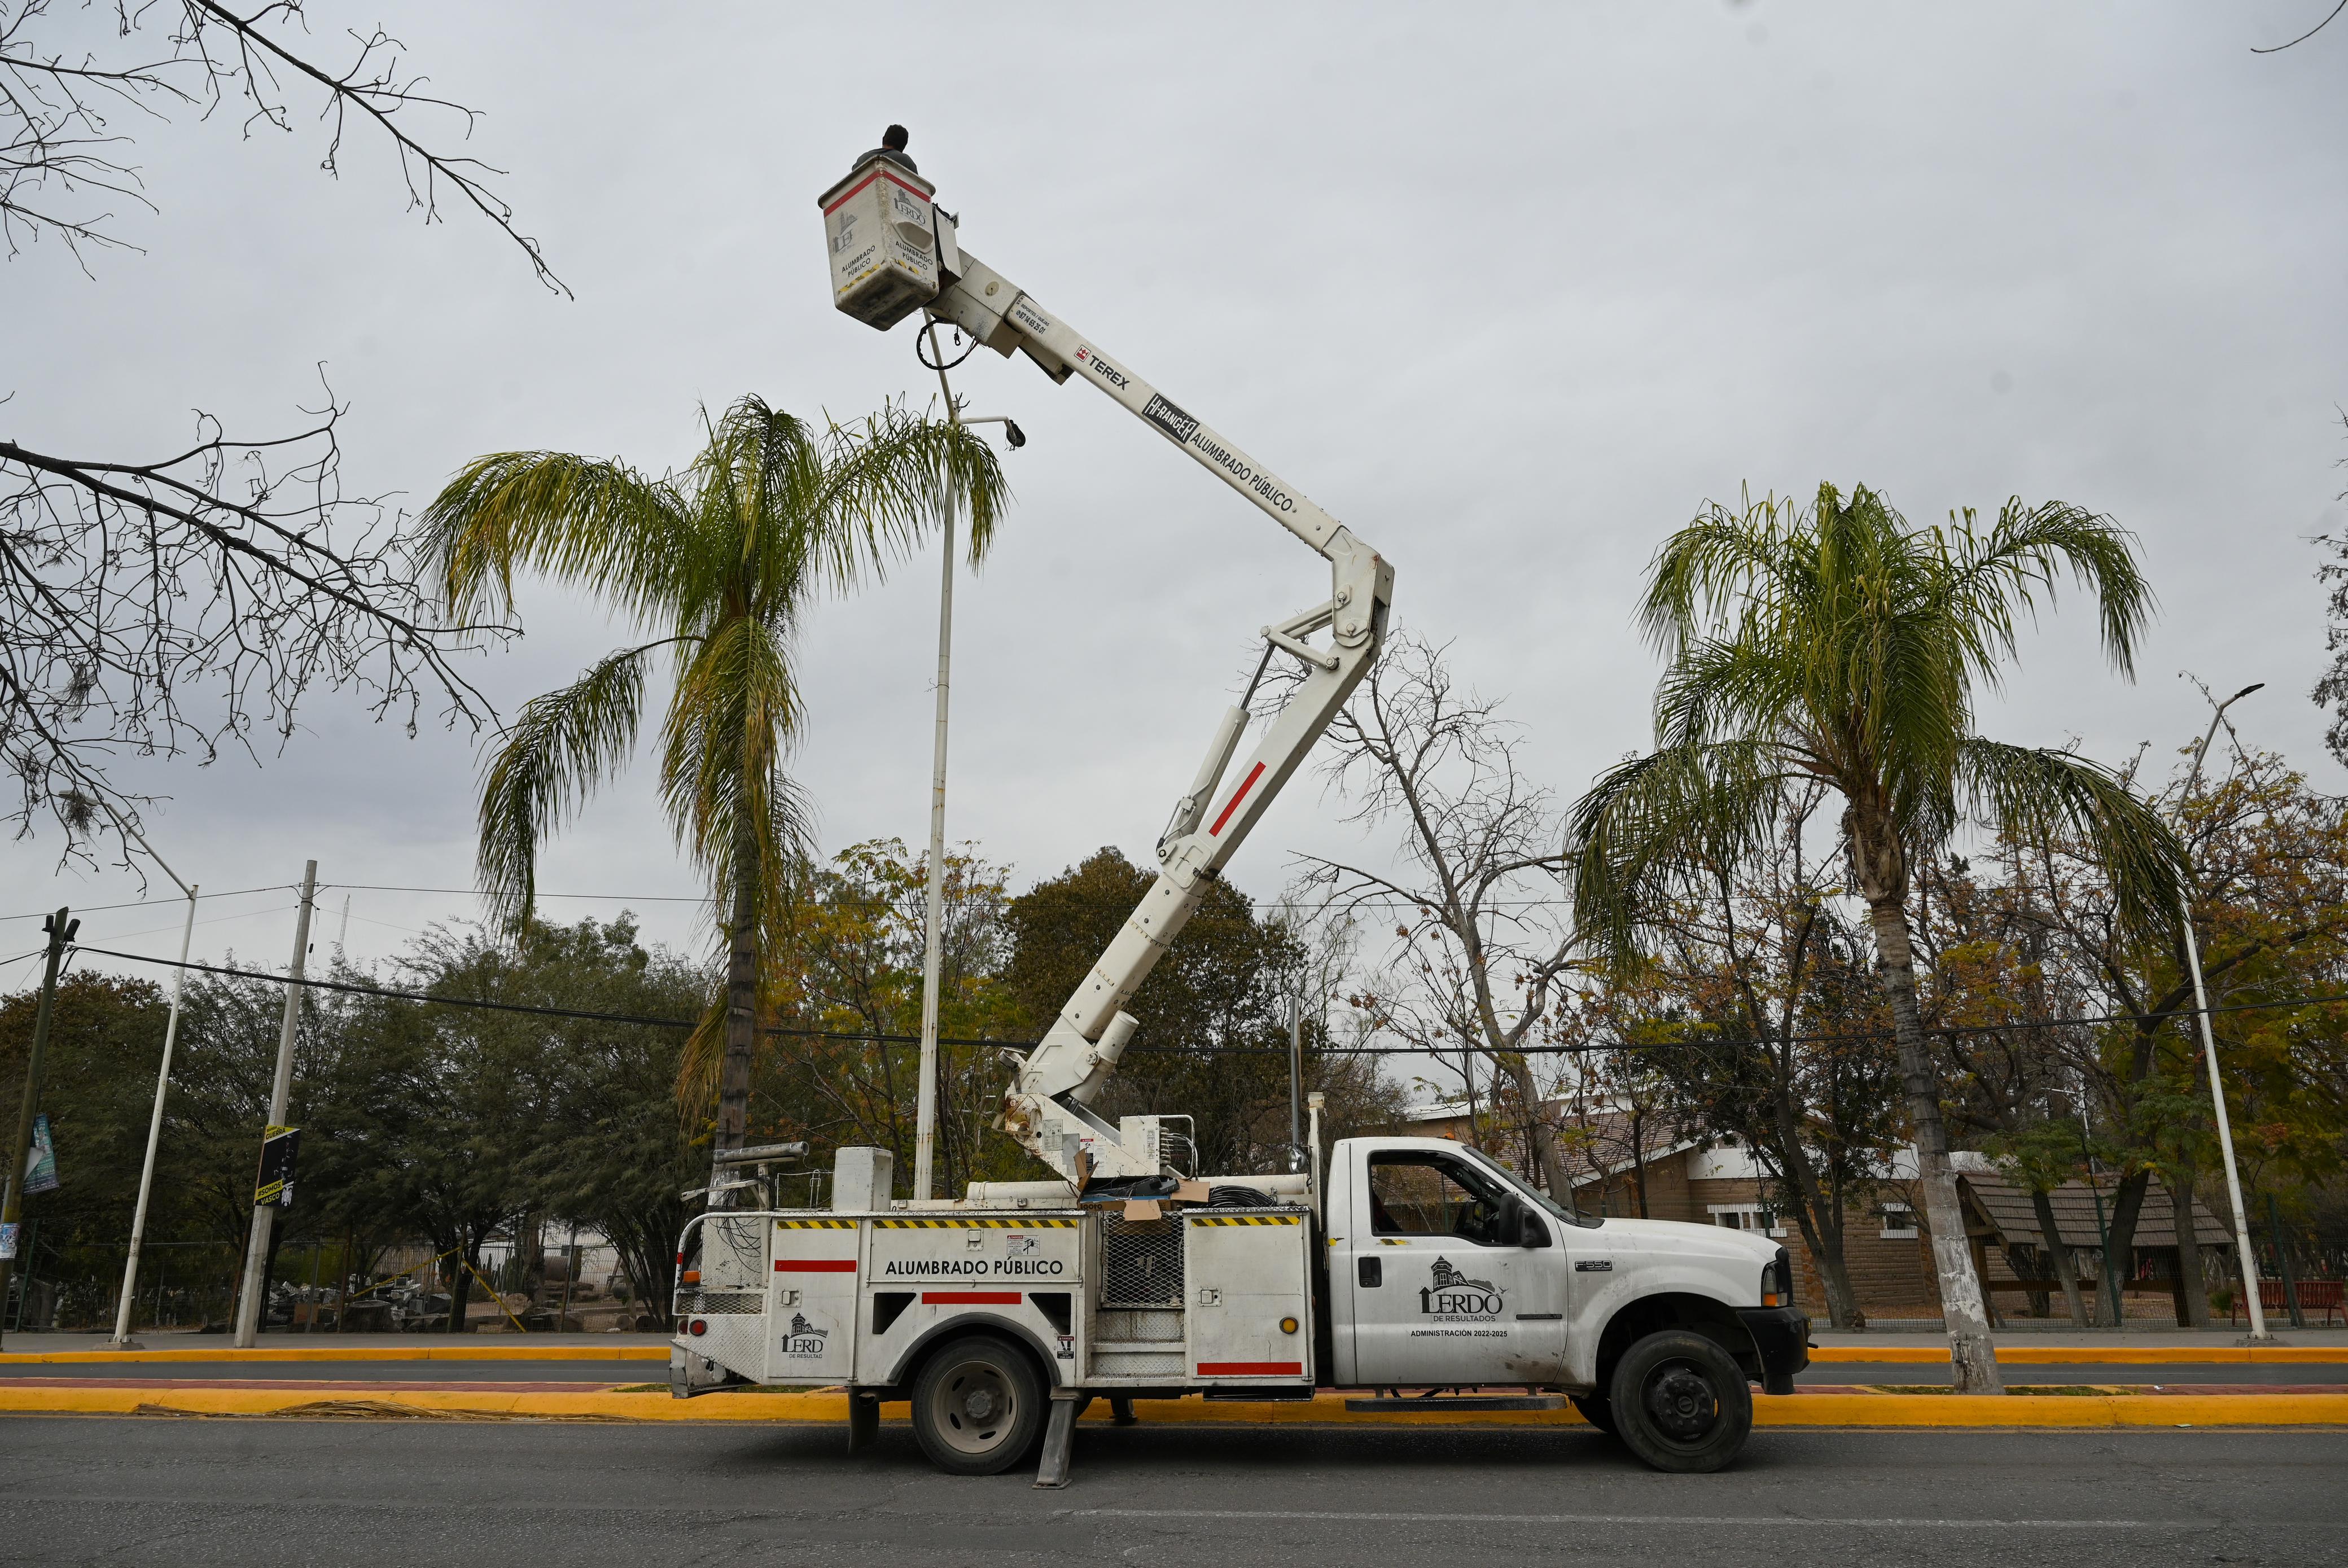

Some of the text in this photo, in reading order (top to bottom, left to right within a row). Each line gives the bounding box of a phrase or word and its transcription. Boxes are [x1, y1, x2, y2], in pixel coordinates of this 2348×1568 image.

[894, 198, 926, 225] LERDO
[842, 245, 875, 273] ALUMBRADO
[896, 241, 933, 265] ALUMBRADO
[903, 252, 928, 270] PÚBLICO
[848, 257, 871, 277] PÚBLICO
[1021, 304, 1037, 317] REPORTES
[1037, 316, 1050, 327] QUEJAS
[1029, 319, 1036, 327] 65
[1089, 354, 1130, 391] TEREX
[1144, 395, 1197, 441] HI-RANGER
[1190, 432, 1293, 511] ALUMBRADO PÚBLICO
[266, 1128, 286, 1140] GUERRA
[258, 1181, 281, 1197] #SOMOS
[261, 1193, 280, 1206] VASCO
[885, 1256, 1063, 1275] ALUMBRADO PÚBLICO
[1418, 1286, 1503, 1314] LERDO
[781, 1333, 823, 1353] LERD
